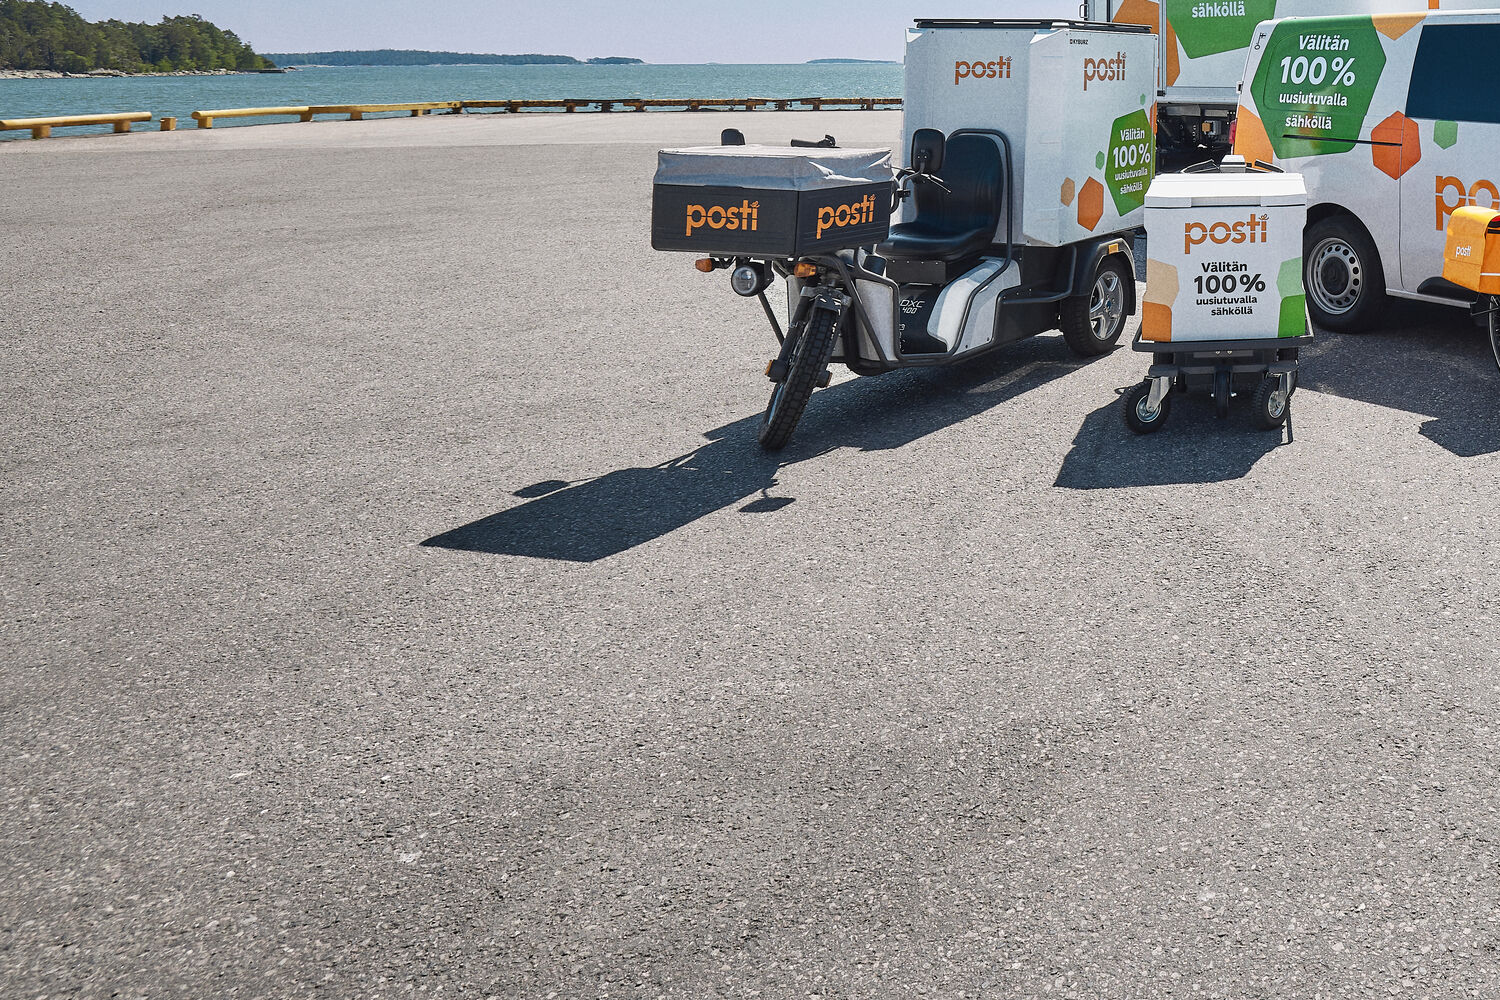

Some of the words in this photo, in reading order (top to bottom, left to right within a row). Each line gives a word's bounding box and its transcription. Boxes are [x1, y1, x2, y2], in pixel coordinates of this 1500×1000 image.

[1191, 0, 1246, 18] sähköllä
[1299, 34, 1350, 51] Välitän
[955, 56, 1012, 86] posti
[1083, 51, 1127, 92] posti
[1279, 91, 1348, 107] uusiutuvalla
[1285, 114, 1332, 130] sähköllä
[1120, 127, 1145, 142] Välitän
[1114, 166, 1148, 181] uusiutuvalla
[1120, 181, 1143, 195] sähköllä
[685, 200, 760, 237] posti
[816, 193, 876, 240] posti
[1184, 213, 1269, 255] posti
[1455, 245, 1472, 258] posti
[1201, 261, 1248, 273] Välitän
[1195, 295, 1258, 306] uusiutuvalla
[1211, 306, 1253, 316] sähköllä
